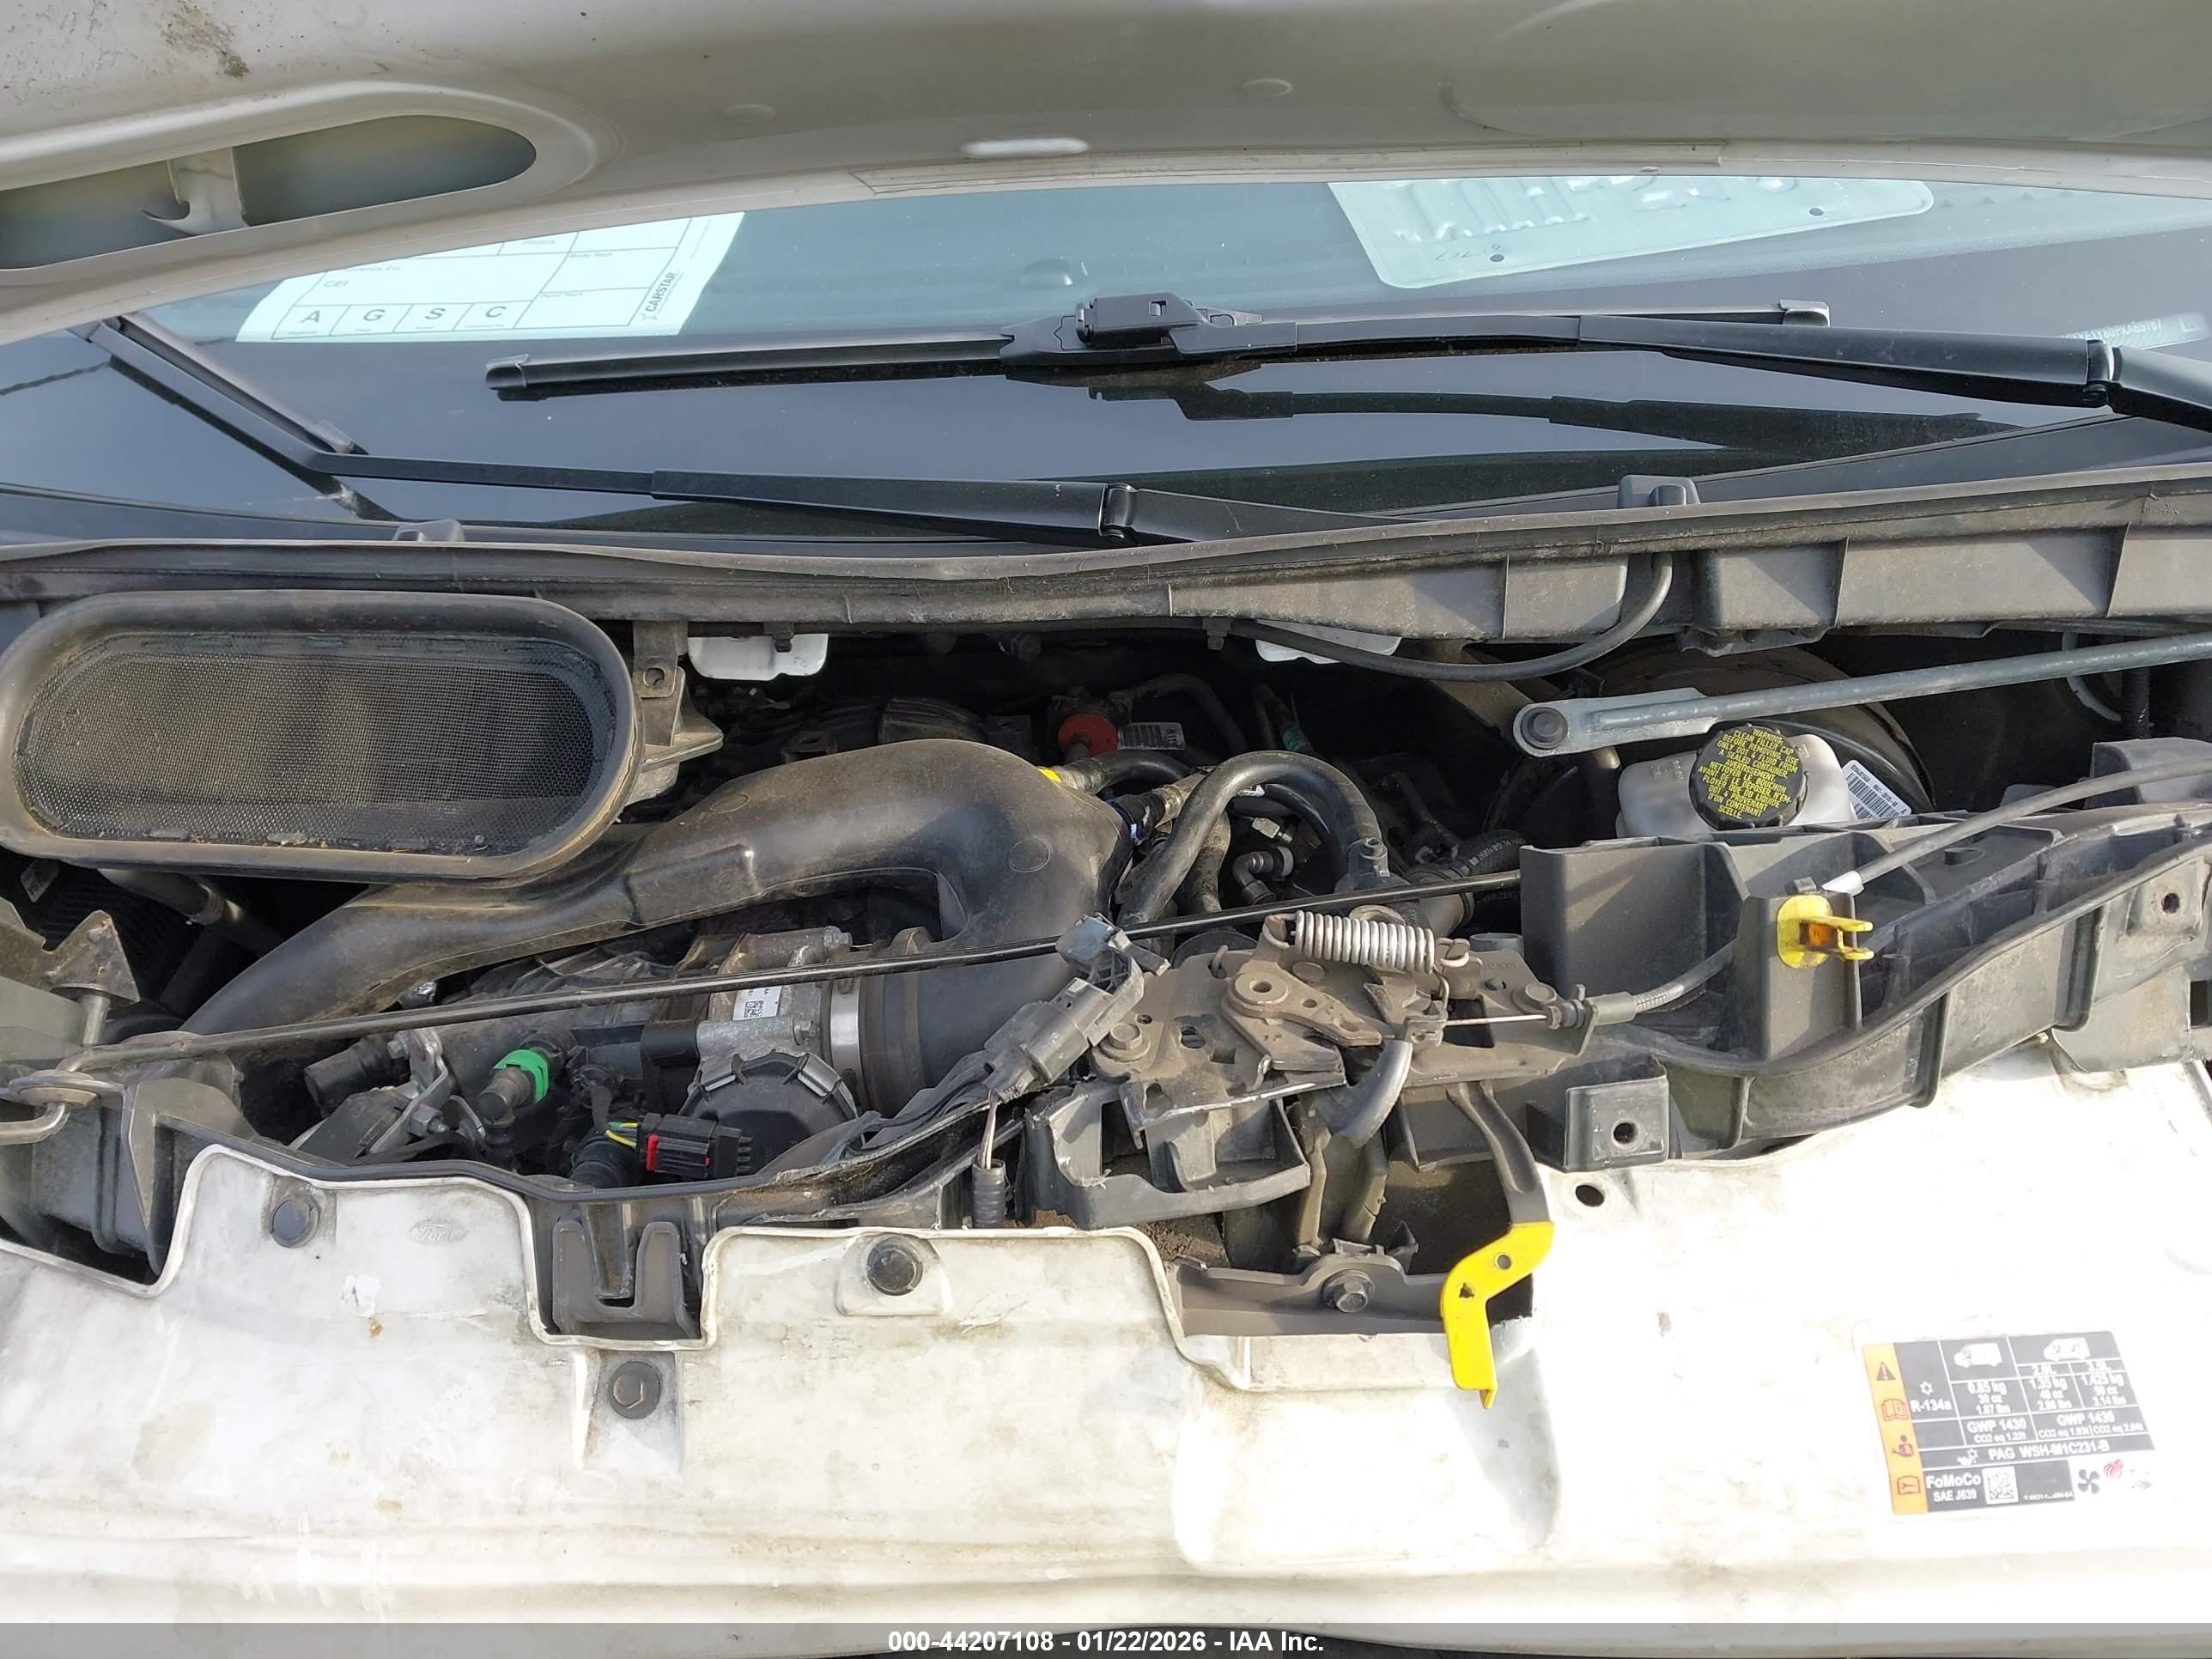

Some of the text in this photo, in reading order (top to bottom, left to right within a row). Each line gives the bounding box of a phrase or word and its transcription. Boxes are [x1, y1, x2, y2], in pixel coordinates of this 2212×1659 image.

[646, 271, 678, 313] CARSTAR
[301, 310, 320, 323] A
[363, 309, 386, 321] G
[425, 307, 446, 319] S
[485, 306, 507, 318] C
[1733, 729, 1794, 756] CLEAN FILLER CAP
[1717, 739, 1734, 750] ONLY
[1758, 754, 1777, 766] FLUID
[1778, 761, 1797, 773] FROM
[1723, 734, 1746, 747] BEFORE
[1784, 755, 1799, 766] USE
[1726, 751, 1750, 764] SEALED
[1698, 765, 1718, 776] AVANT
[1720, 772, 1729, 781] DE
[1731, 776, 1741, 785] LE
[1709, 761, 1786, 793] NETTOYER LE BOUCHON
[1702, 775, 1780, 808] PLOYER QUE DU LIQUIDE
[1725, 799, 1762, 817] CONTENANT
[1729, 793, 1767, 811] PROVENANT
[2053, 1376, 2068, 1391] kg
[2109, 1372, 2125, 1387] kg
[1991, 1381, 2008, 1395] kg
[2052, 1389, 2064, 1399] oz
[2106, 1385, 2119, 1395] oz
[1910, 1399, 1953, 1413] R-134a
[1990, 1395, 2004, 1403] oz
[2057, 1410, 2116, 1427] GWP 1430
[1966, 1418, 2027, 1434] GWP 1430
[2039, 1428, 2057, 1438] CO2
[2093, 1424, 2112, 1435] CO2
[1974, 1433, 1994, 1443] CO2
[1995, 1434, 2006, 1444] eq
[1988, 1448, 2015, 1462] PAG
[1926, 1474, 1981, 1490] FoMoCo
[1933, 1489, 1978, 1503] SAE J639
